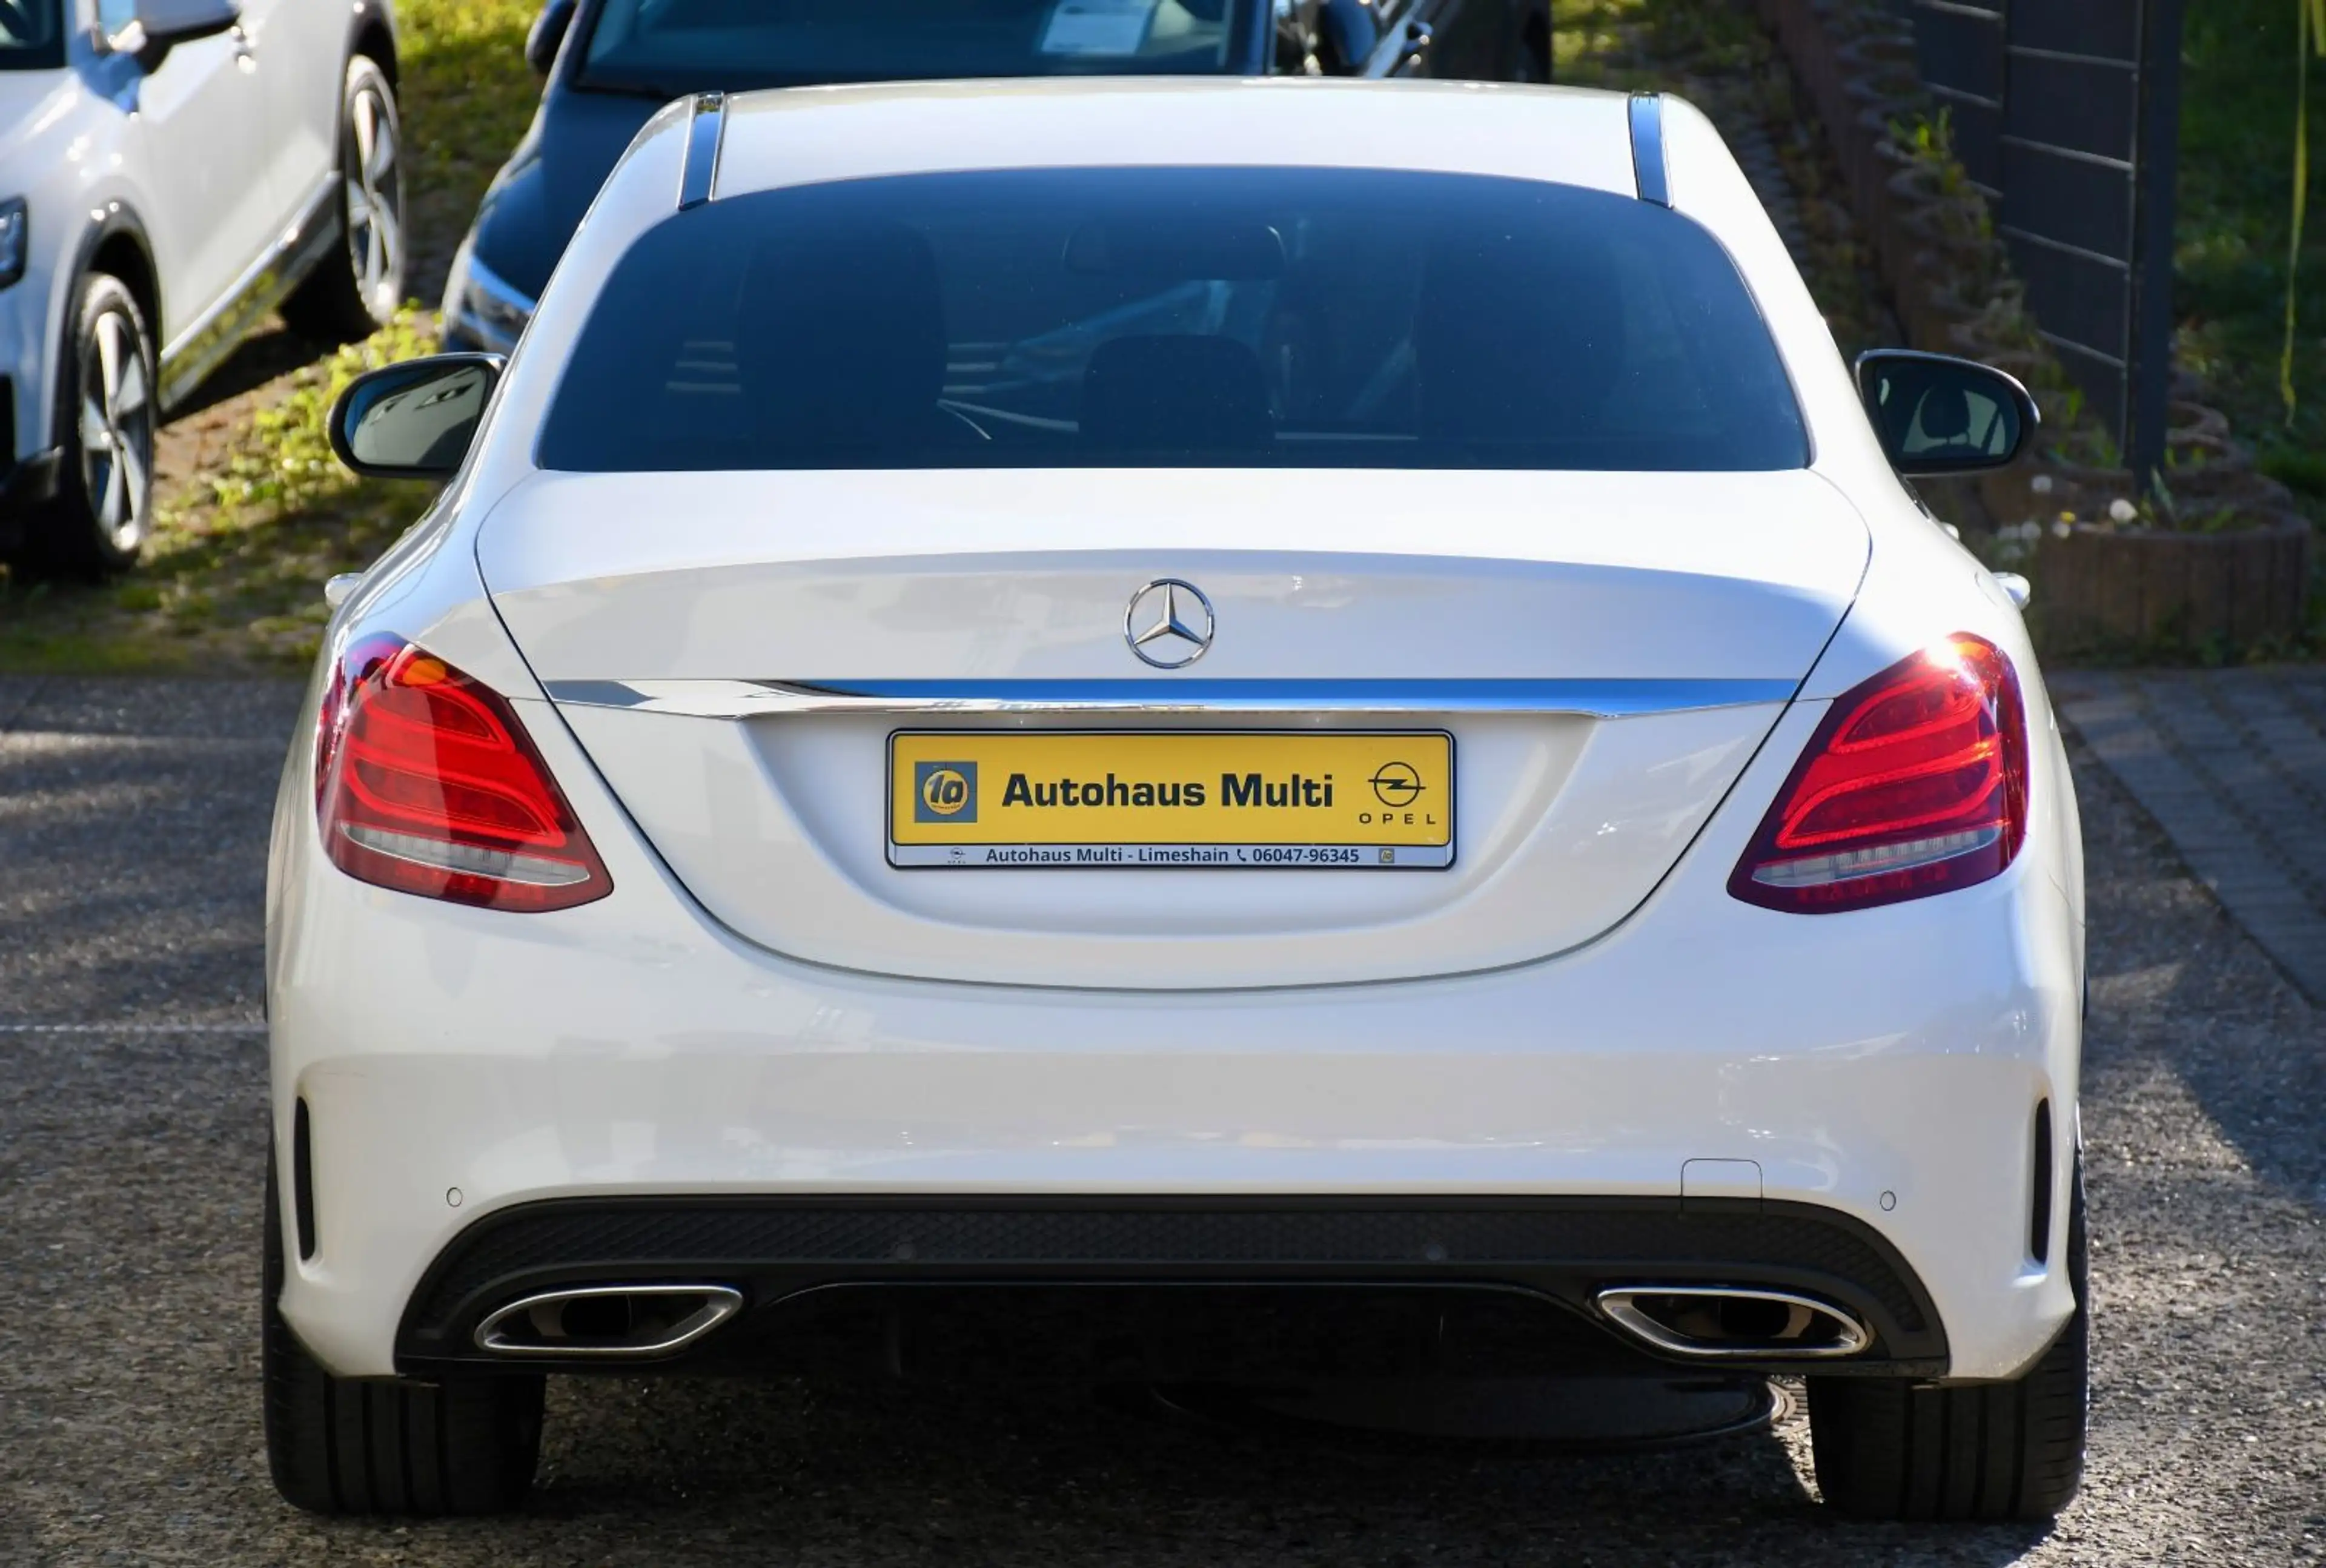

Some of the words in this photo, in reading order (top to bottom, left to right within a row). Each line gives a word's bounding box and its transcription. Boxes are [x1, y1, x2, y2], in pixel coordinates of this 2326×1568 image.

[1001, 773, 1205, 807] Autohaus
[1221, 773, 1333, 807] Multi
[1359, 813, 1436, 824] OPEL
[986, 848, 1071, 862] Autohaus
[1077, 847, 1122, 861] Multi
[1139, 847, 1228, 861] Limeshain
[1253, 849, 1359, 862] 06047-96345
